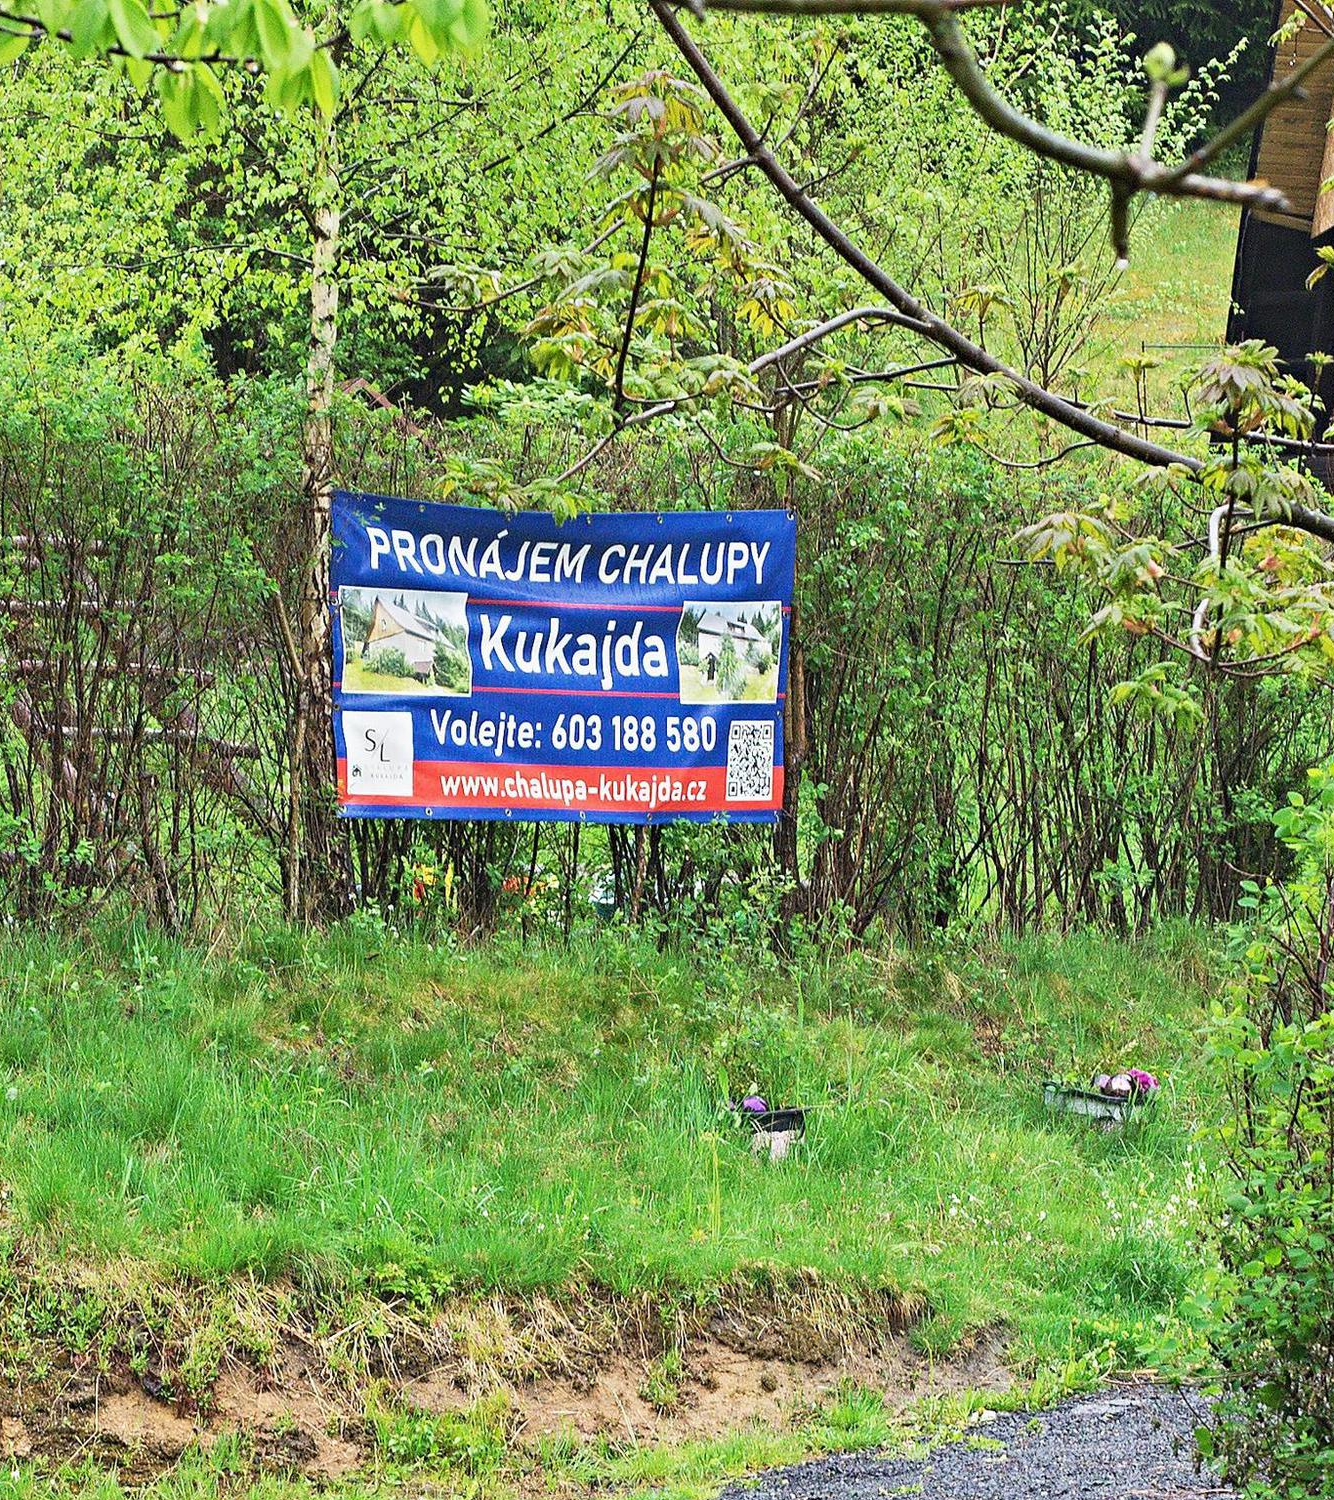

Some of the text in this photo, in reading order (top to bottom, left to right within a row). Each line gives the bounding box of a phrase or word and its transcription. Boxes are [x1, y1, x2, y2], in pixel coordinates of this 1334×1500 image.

[366, 527, 771, 585] PRONÁJEM CHALUPY
[479, 614, 669, 691] Kukajda
[430, 708, 717, 757] Volejte: 603 188 580
[440, 771, 707, 808] www.chalupa-kukajda.cz
